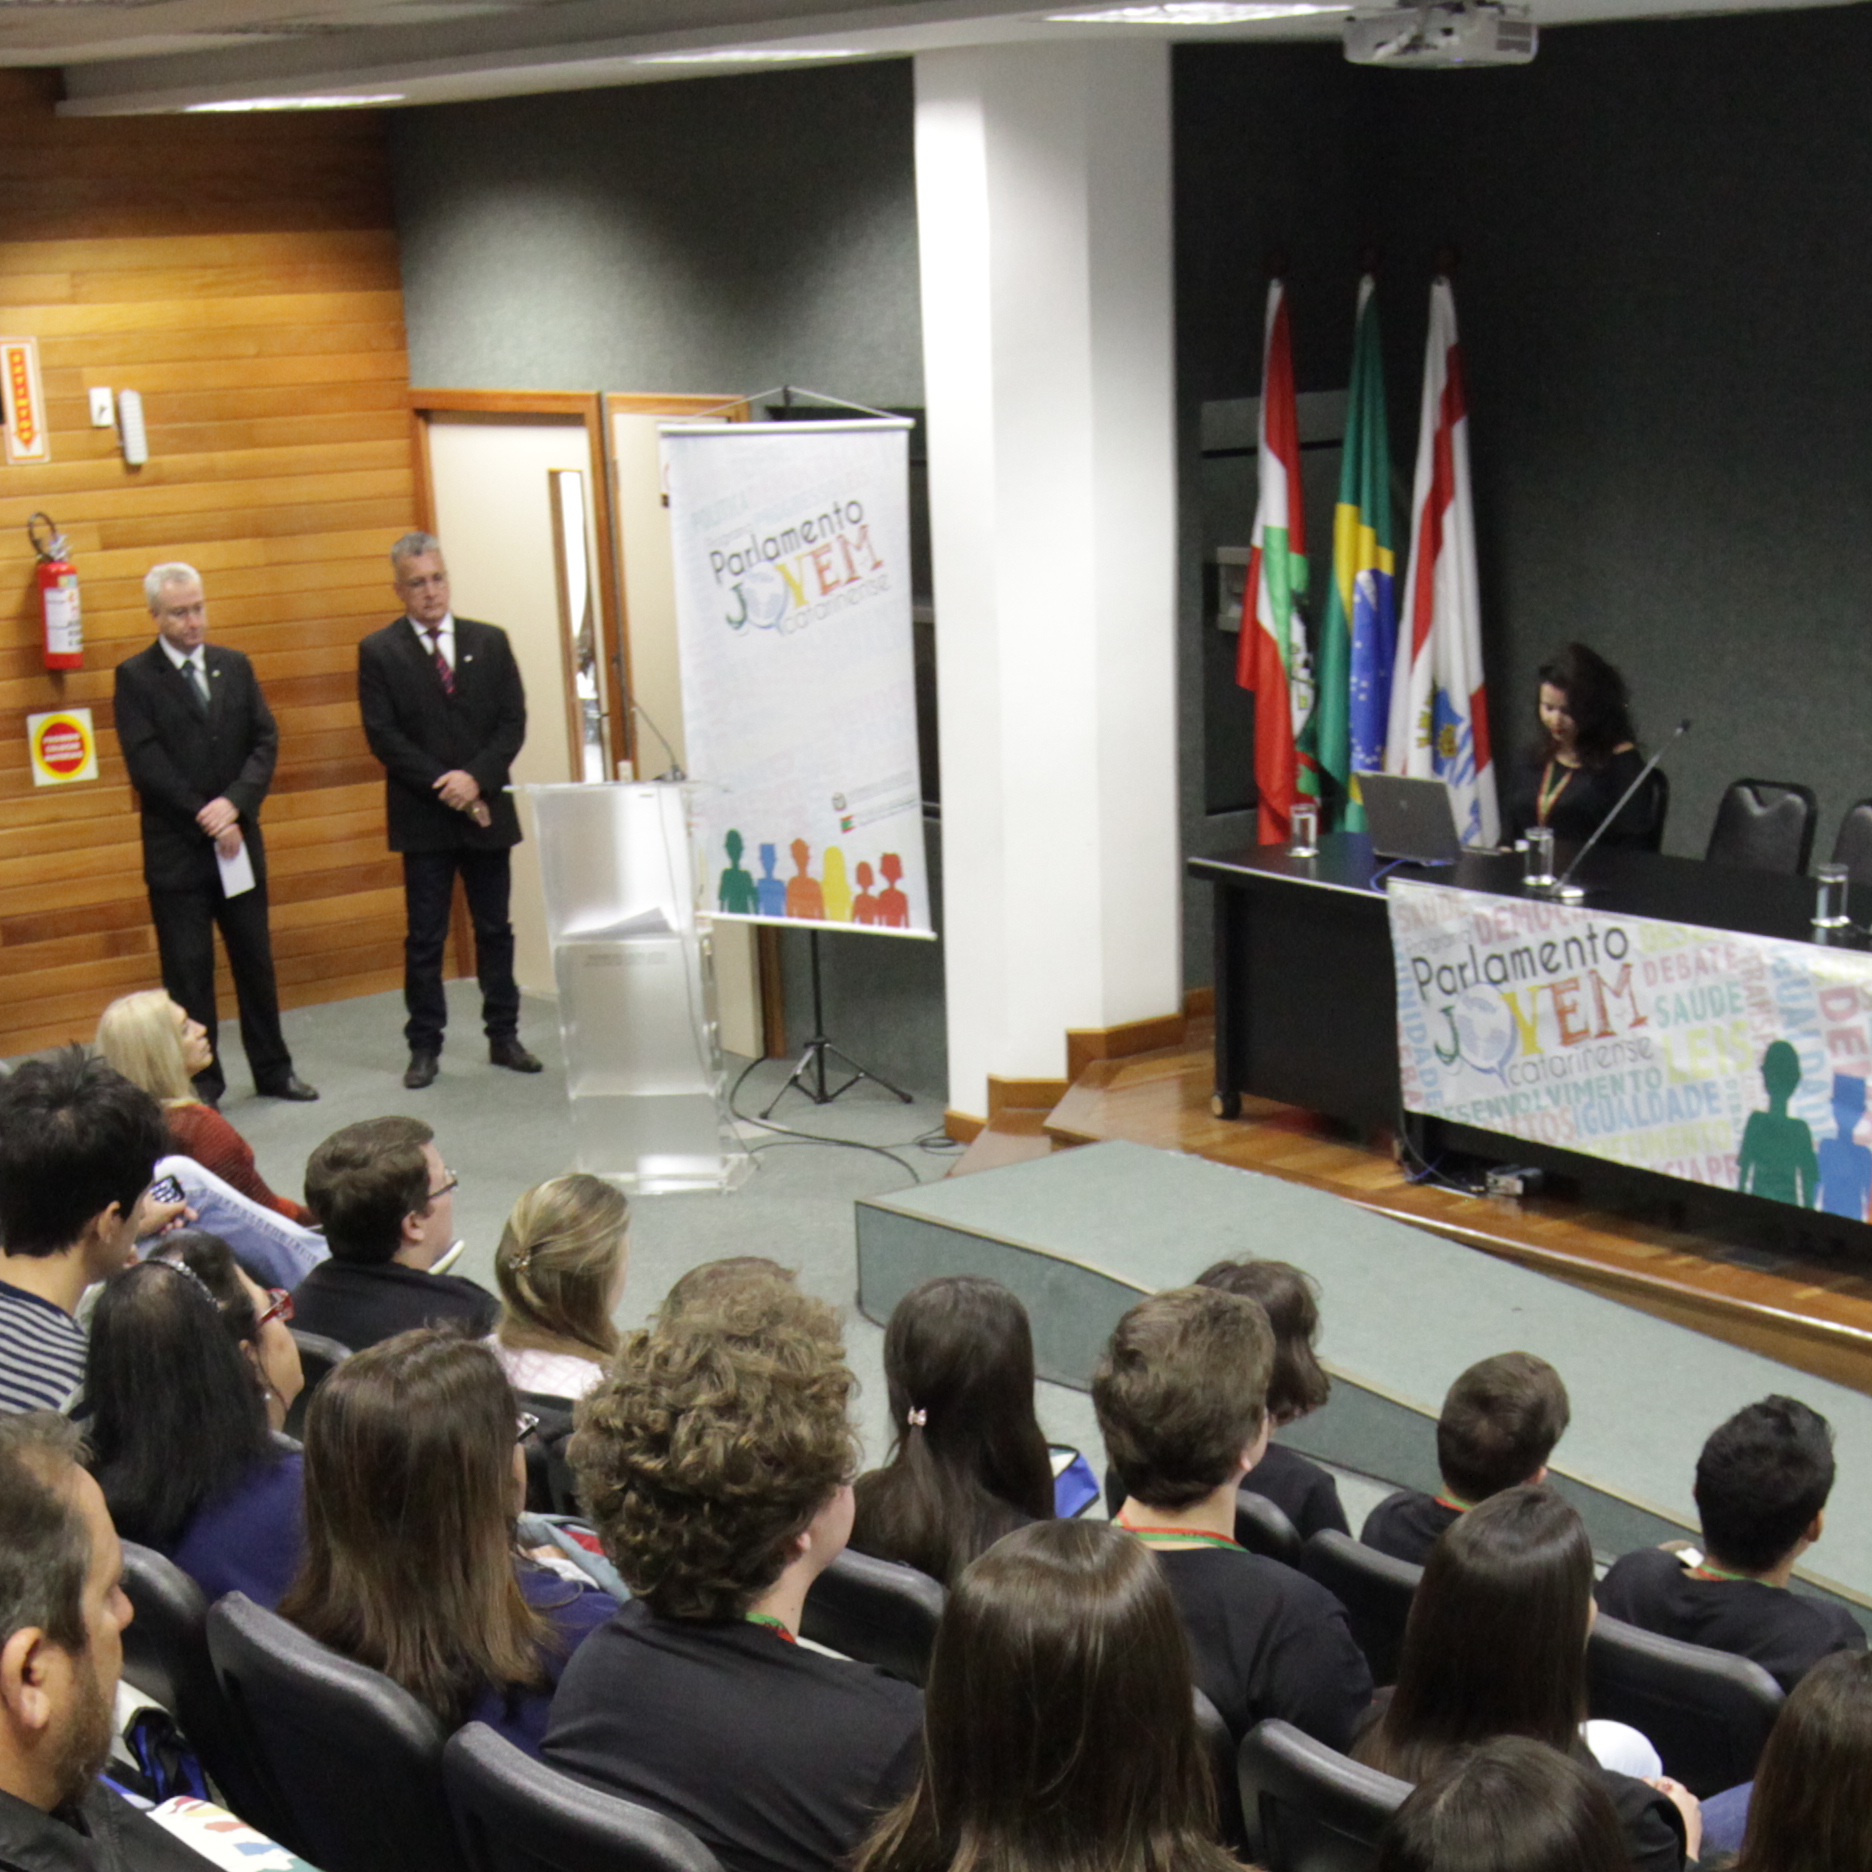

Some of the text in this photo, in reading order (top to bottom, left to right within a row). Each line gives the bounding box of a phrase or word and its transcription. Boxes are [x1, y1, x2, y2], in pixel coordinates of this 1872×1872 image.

[709, 499, 865, 585] Parlamento
[1411, 921, 1631, 1001] Parlamento
[1641, 941, 1741, 988] DEBATE
[1506, 1035, 1657, 1088] catarinense
[1660, 1020, 1756, 1084] LEIS
[1574, 1081, 1723, 1139] IGUALDADE
